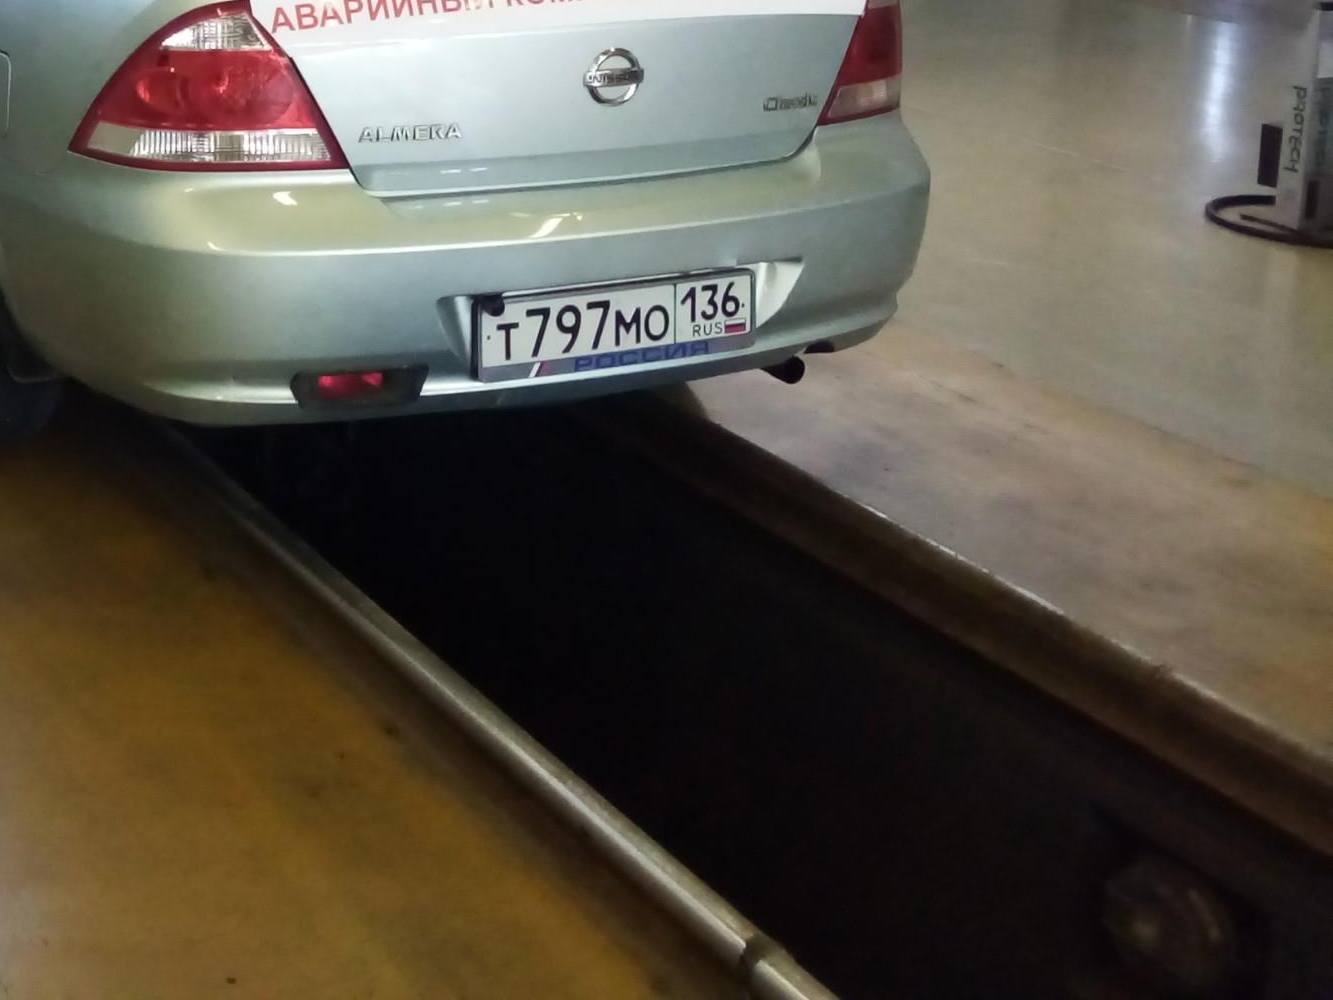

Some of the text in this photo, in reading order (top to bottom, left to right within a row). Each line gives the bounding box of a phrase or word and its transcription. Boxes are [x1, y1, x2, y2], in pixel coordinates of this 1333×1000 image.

[358, 122, 463, 144] ALMERA
[1283, 85, 1308, 173] PROTECH
[680, 281, 740, 323] 136
[692, 321, 723, 338] RUS
[573, 340, 710, 372] РОССИЯ
